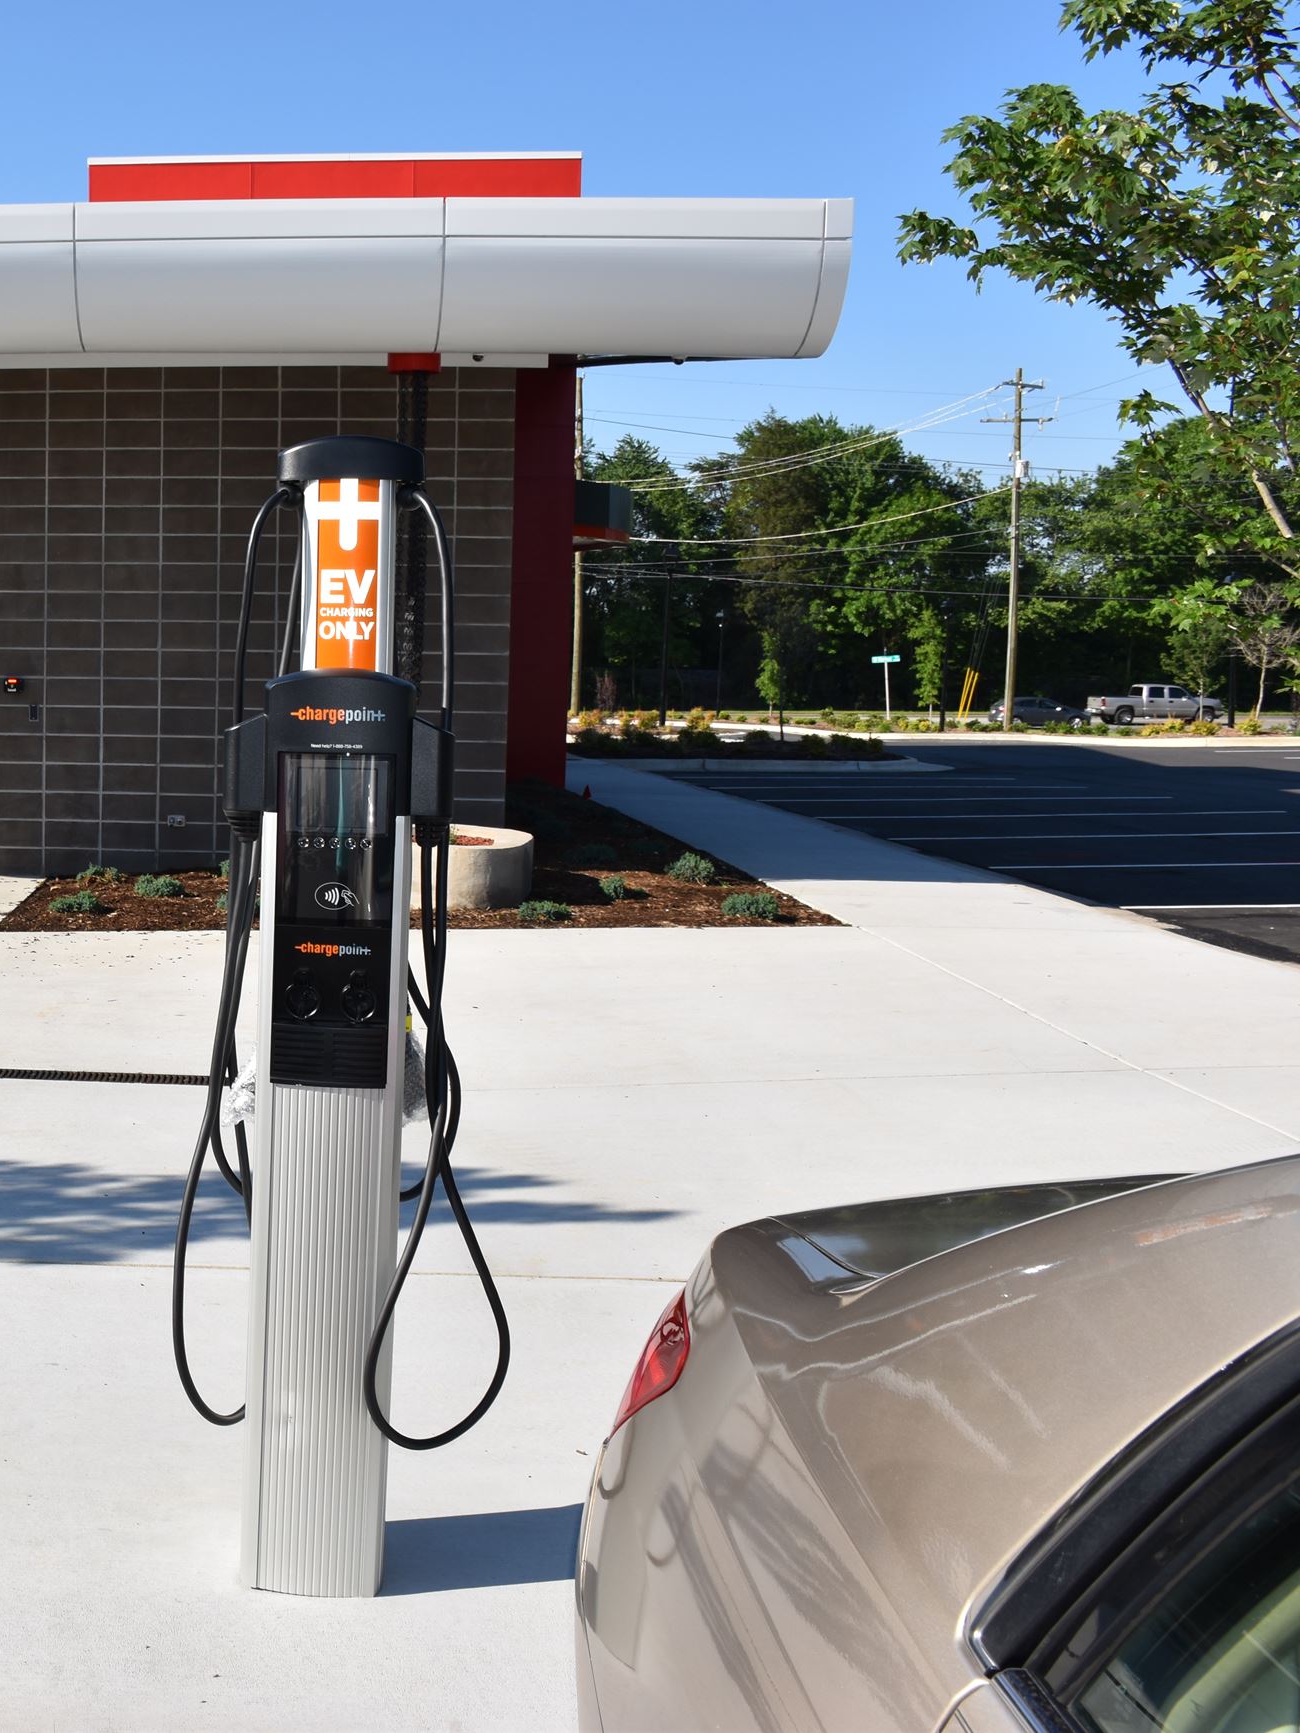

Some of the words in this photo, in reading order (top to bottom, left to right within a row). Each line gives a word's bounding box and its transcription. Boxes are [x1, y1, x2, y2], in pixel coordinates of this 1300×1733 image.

[320, 569, 376, 604] EV
[319, 607, 374, 617] CHARGING
[319, 622, 375, 640] ONLY
